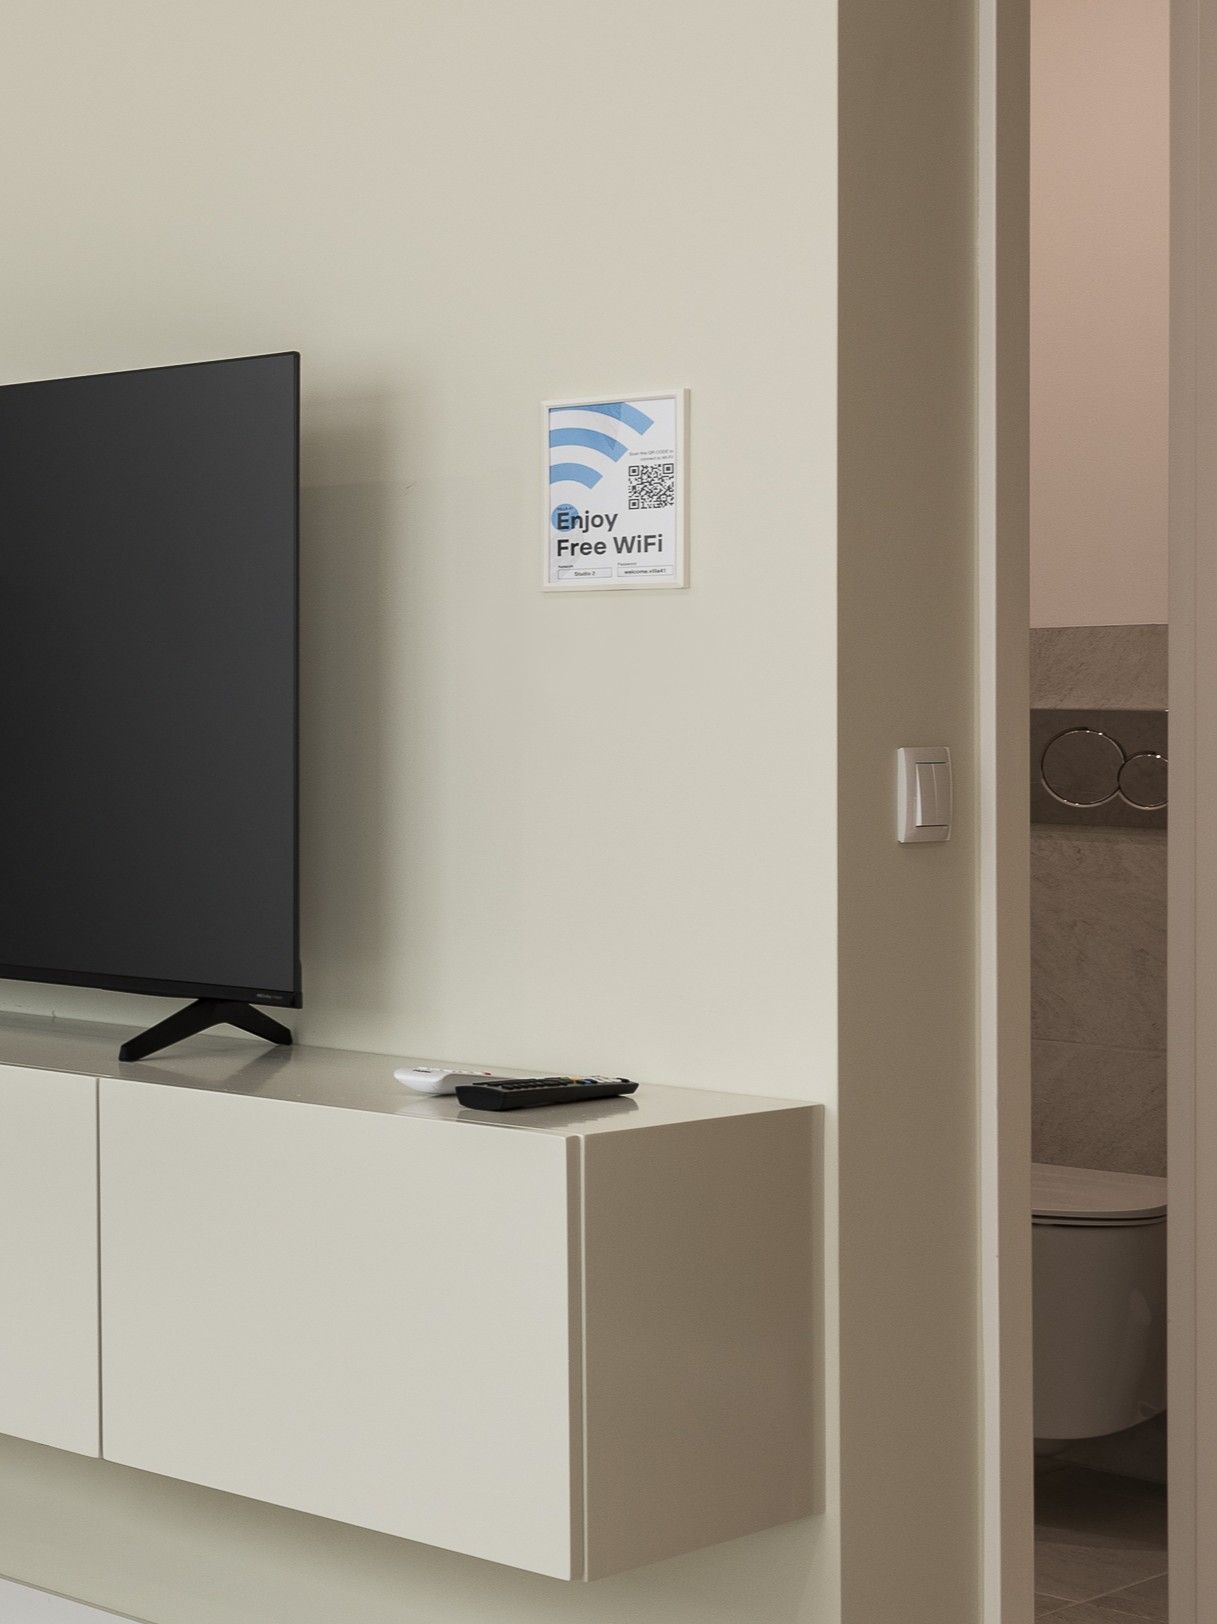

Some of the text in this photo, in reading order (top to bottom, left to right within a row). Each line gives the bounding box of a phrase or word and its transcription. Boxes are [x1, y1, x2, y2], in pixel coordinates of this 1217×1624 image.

[557, 510, 618, 533] Enjoy
[557, 534, 663, 556] Free WiFi
